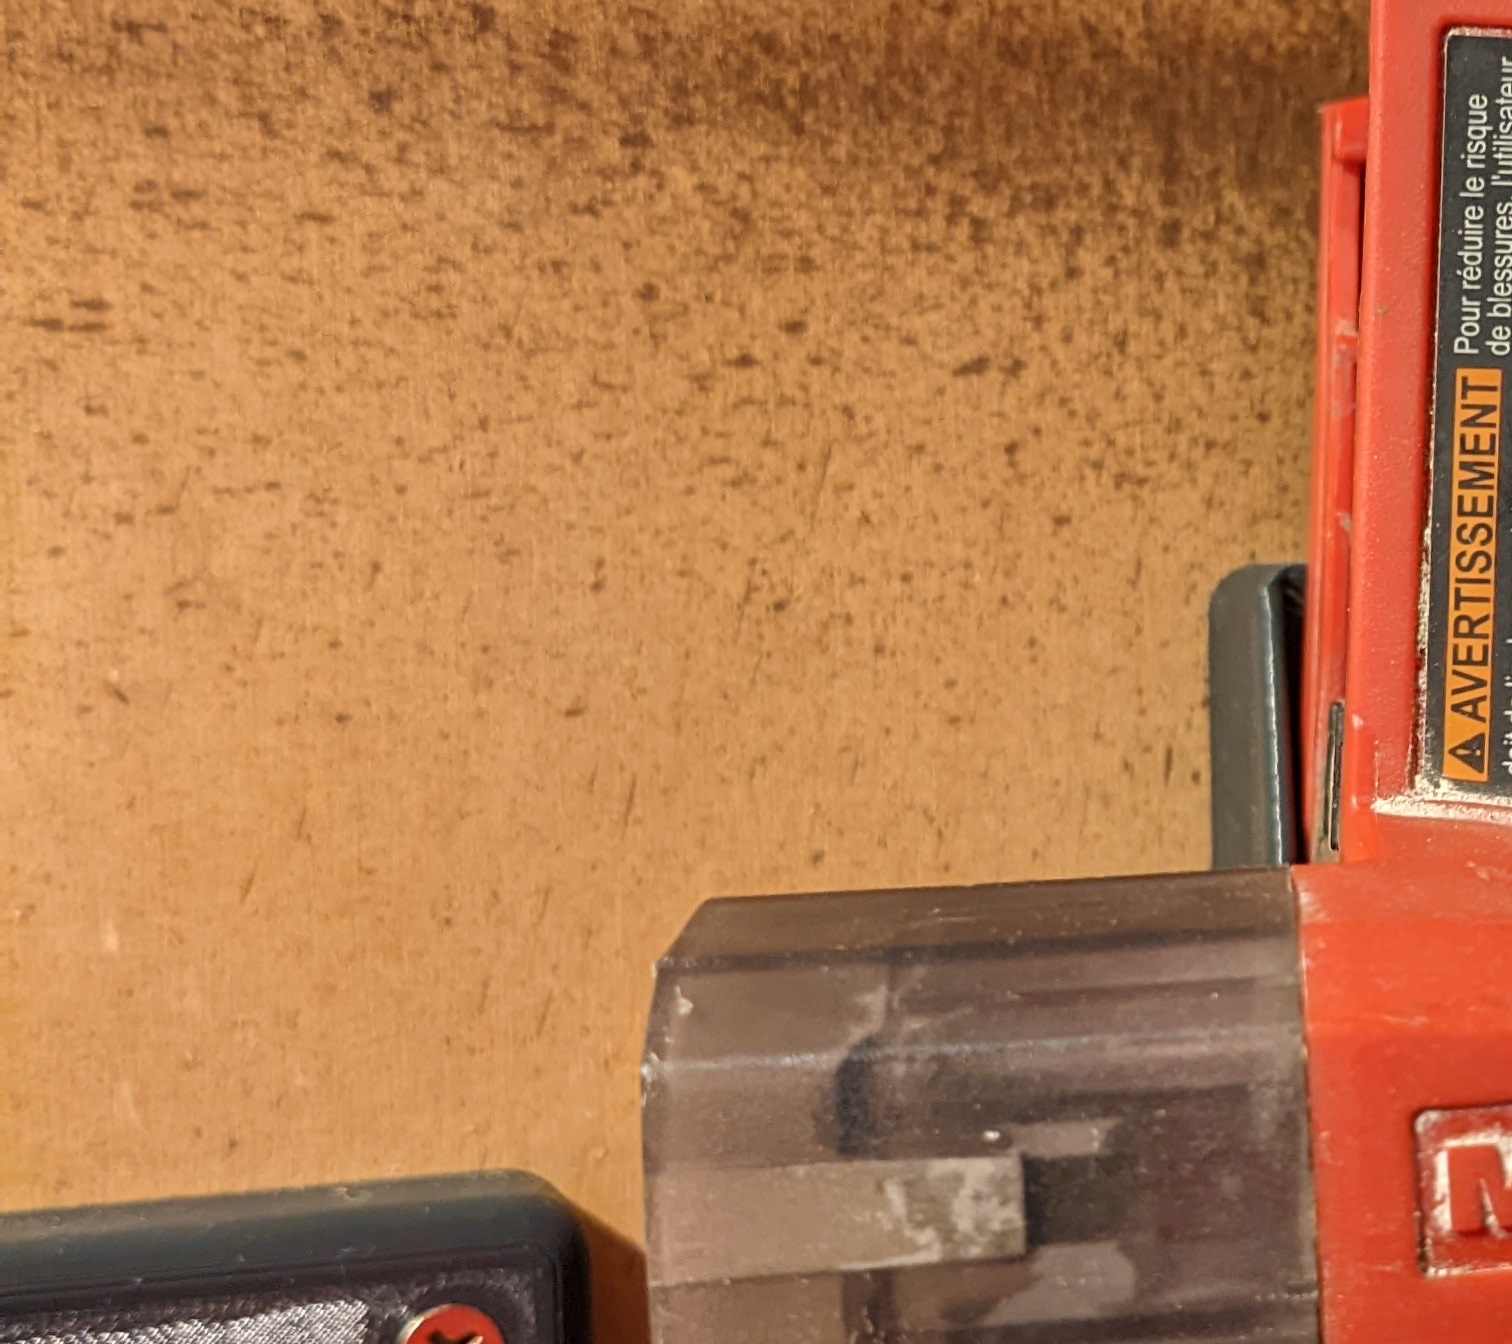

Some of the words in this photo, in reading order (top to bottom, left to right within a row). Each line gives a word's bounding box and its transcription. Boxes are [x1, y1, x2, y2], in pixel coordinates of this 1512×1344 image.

[1460, 94, 1489, 168] risque
[1458, 176, 1485, 197] le
[1456, 206, 1484, 290] réduire
[1454, 300, 1481, 355] Pour
[1486, 326, 1512, 355] de
[1450, 376, 1499, 723] AVERTISSEMENT
